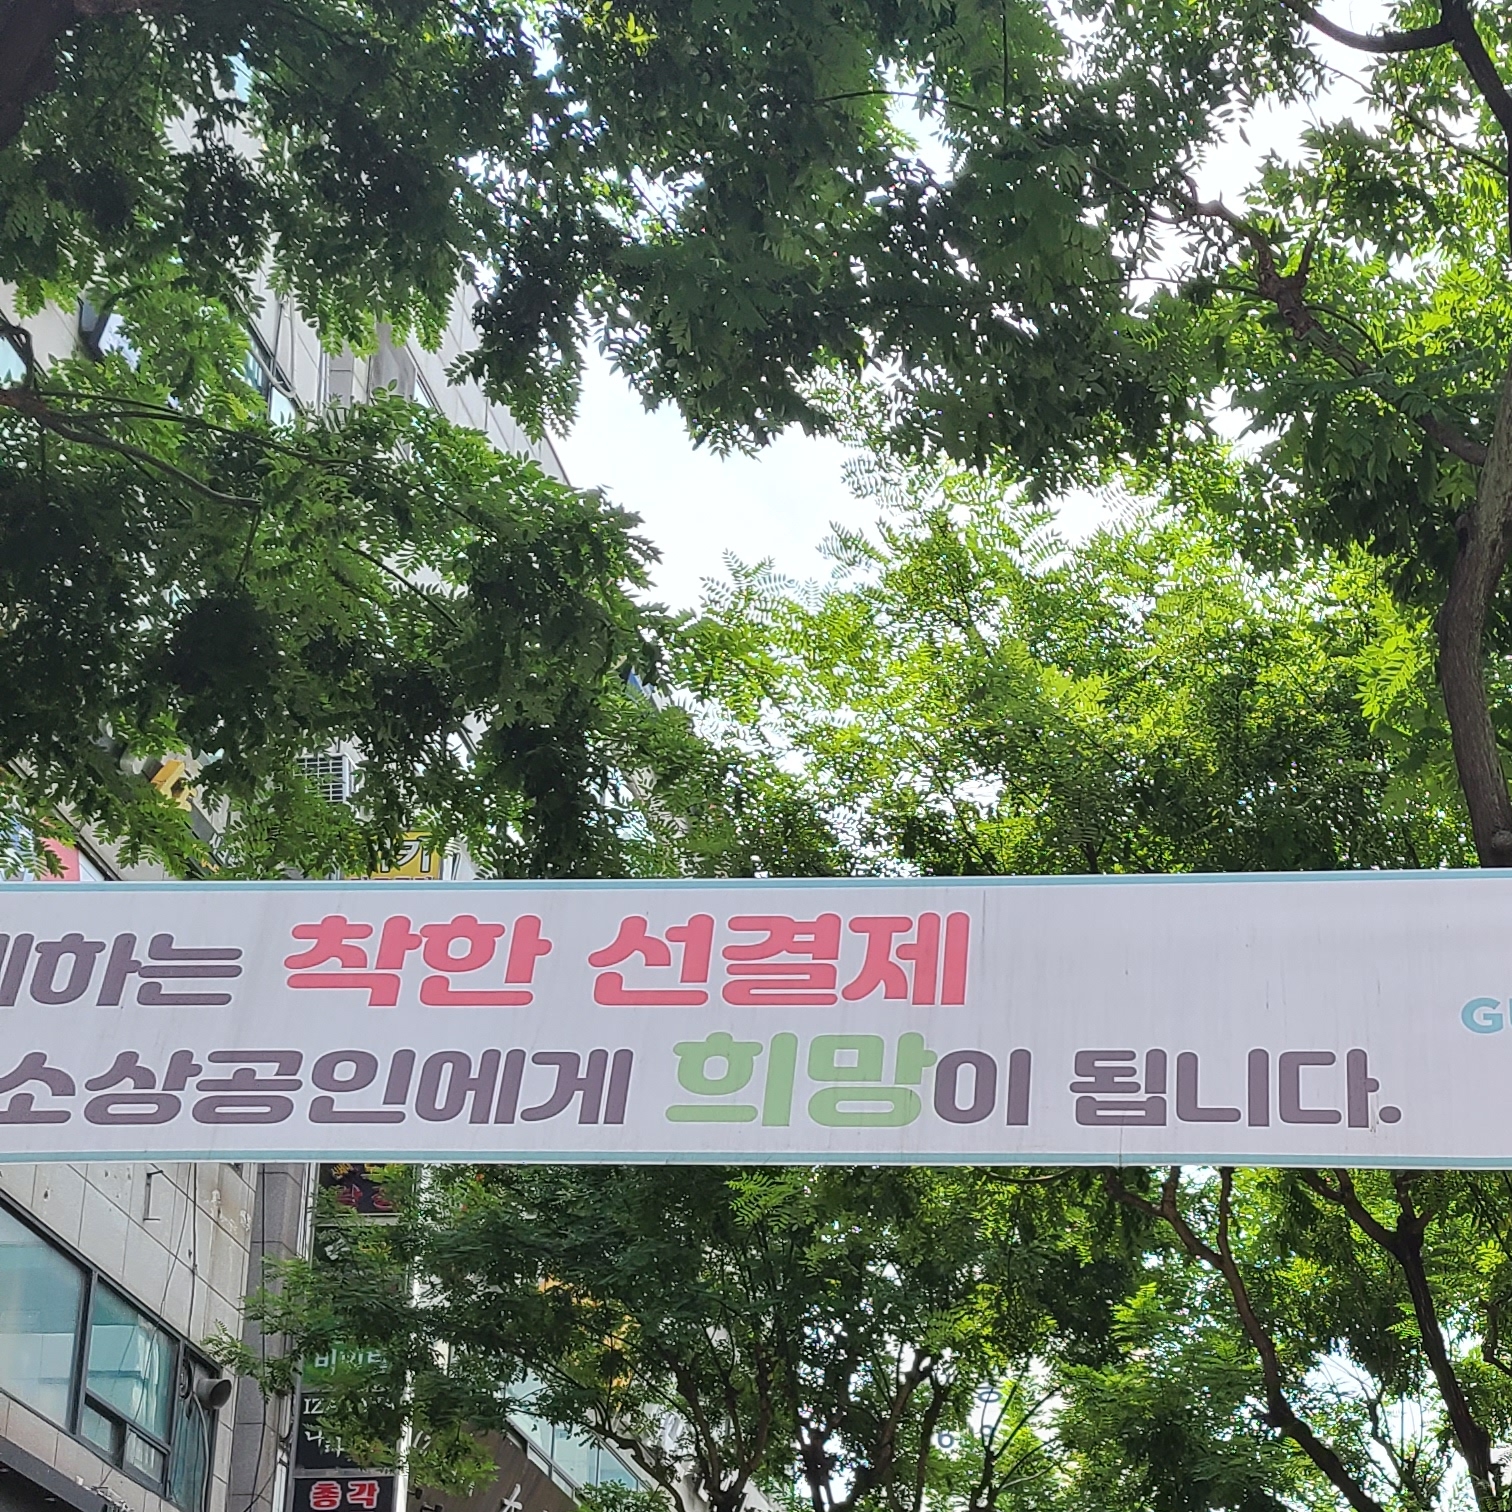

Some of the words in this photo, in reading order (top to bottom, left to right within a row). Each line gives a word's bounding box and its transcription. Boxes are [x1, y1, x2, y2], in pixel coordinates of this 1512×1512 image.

[284, 913, 553, 1008] 착한
[588, 911, 971, 1007] 선결제
[0, 1048, 633, 1126] 소상공인에게
[664, 1031, 1034, 1128] 희망이
[1068, 1047, 1402, 1129] 됩니다.
[309, 1480, 380, 1511] 총각
